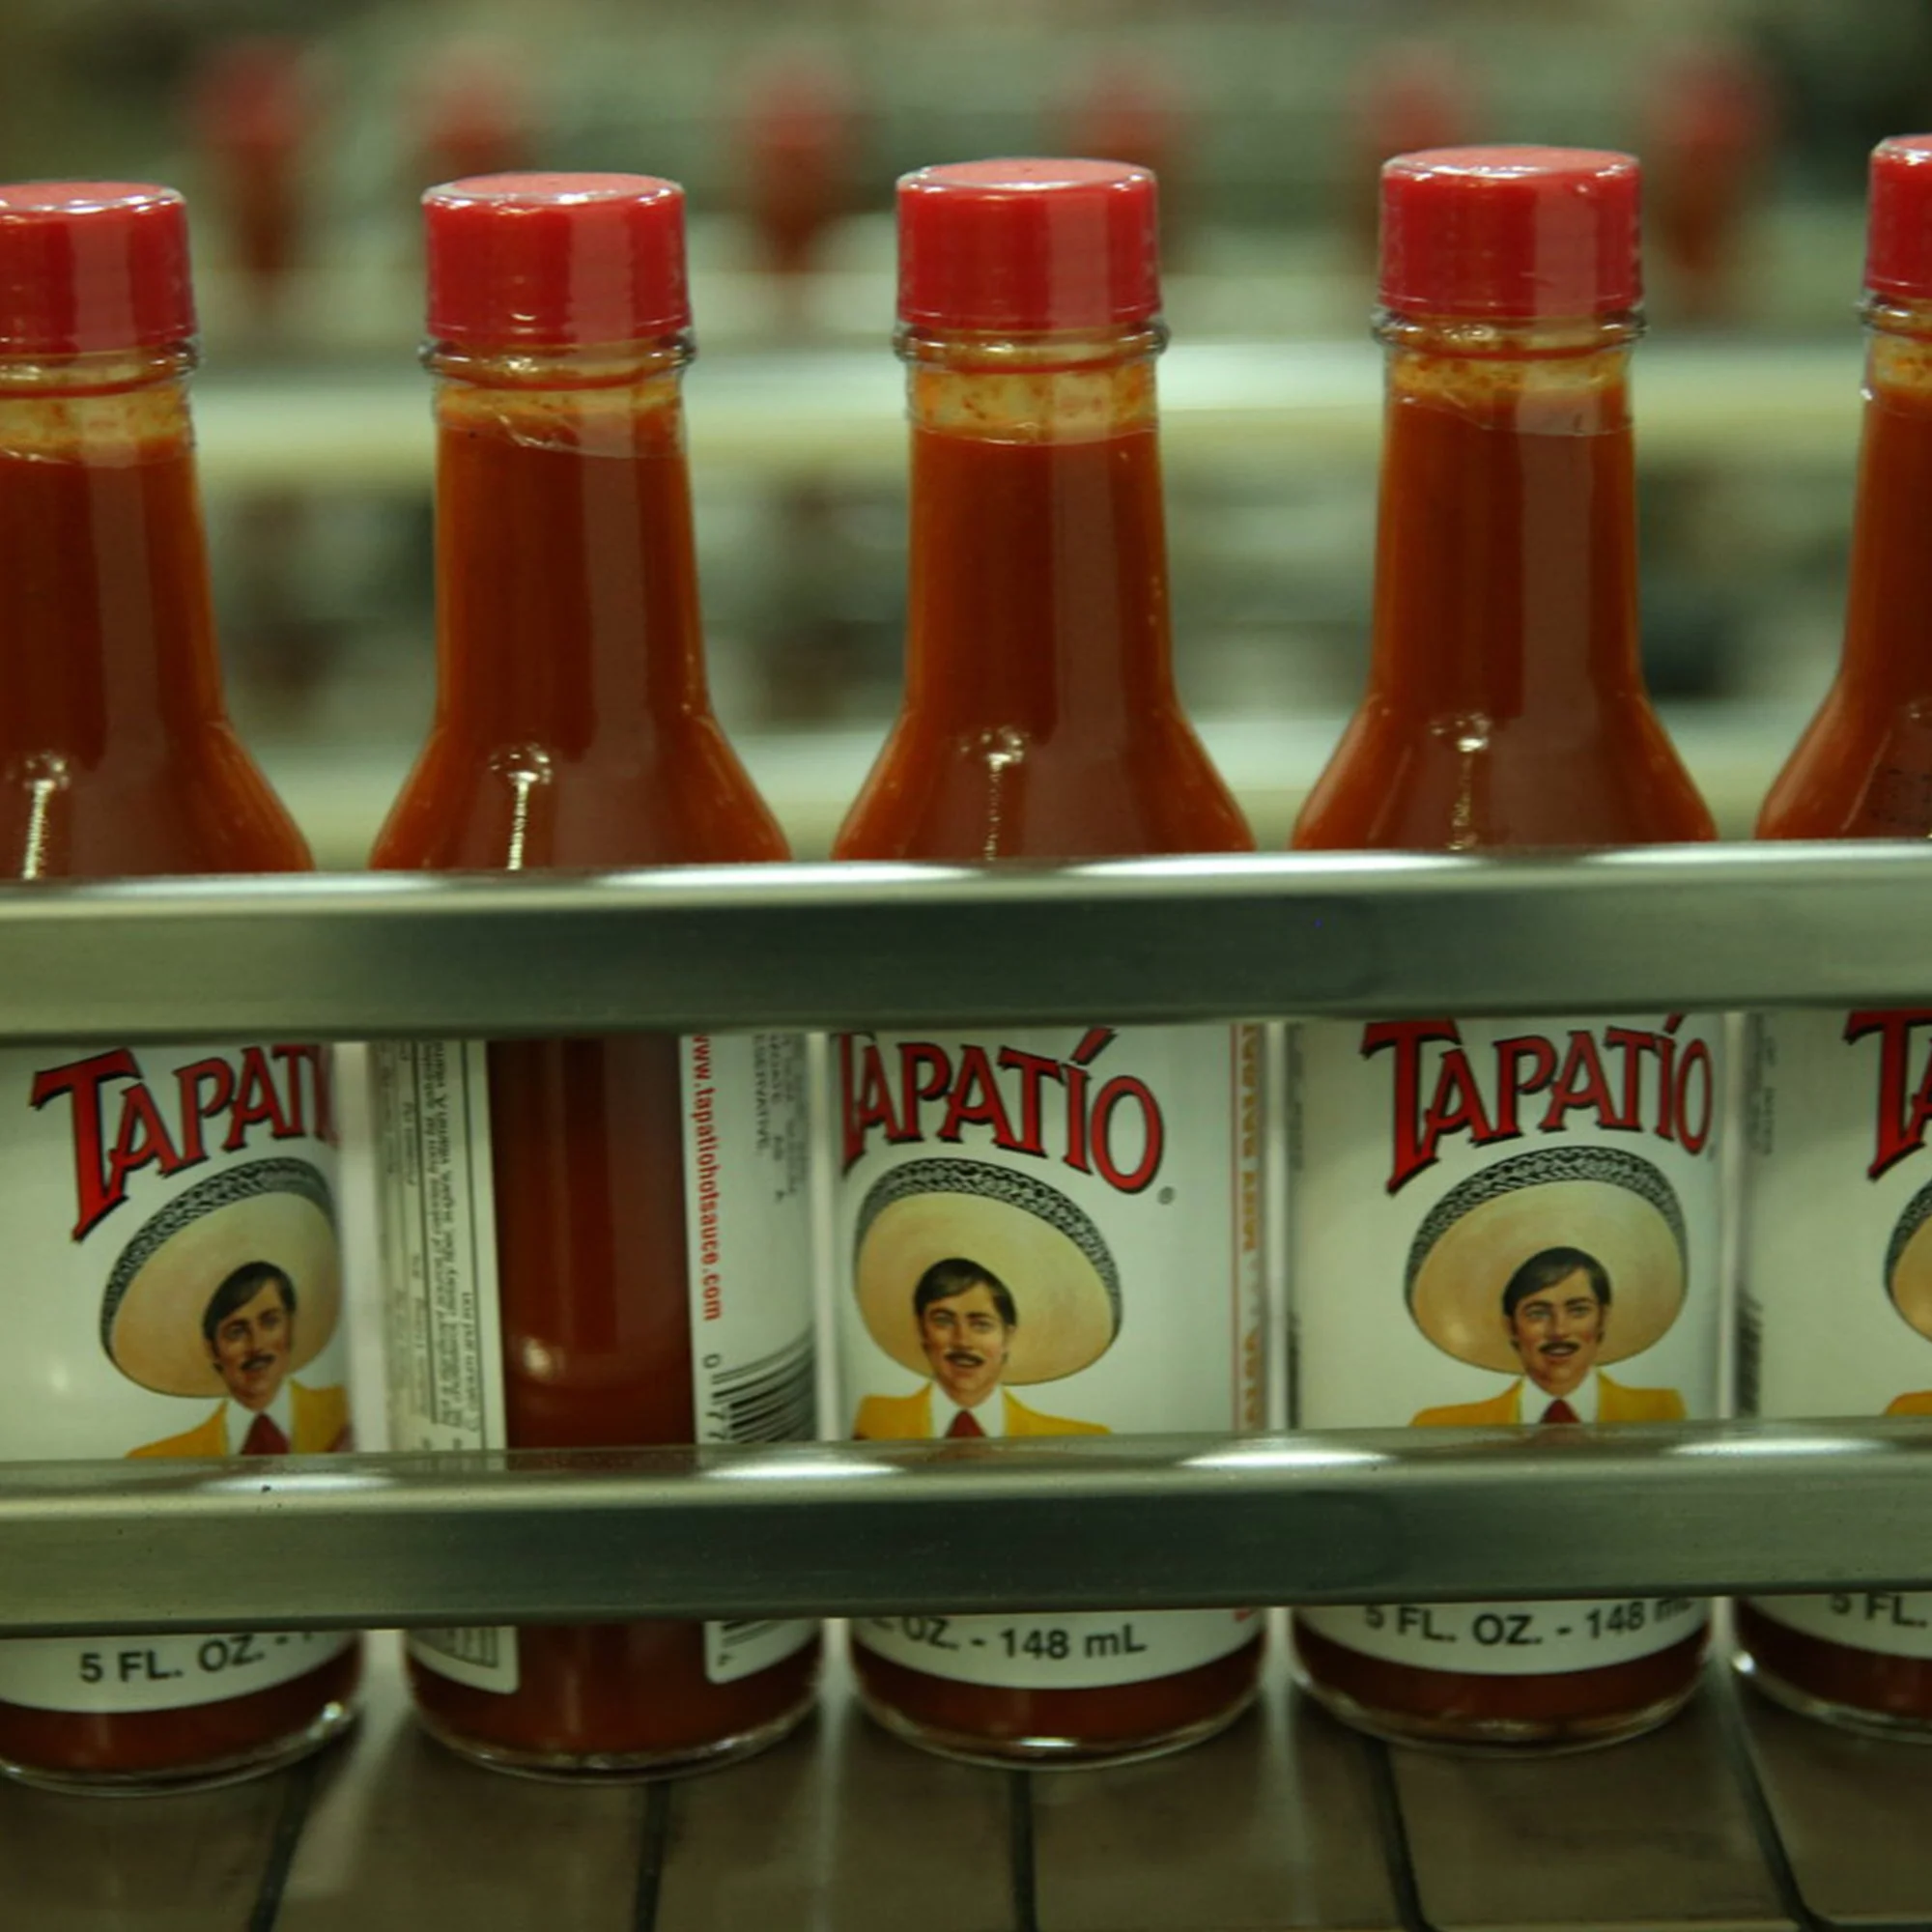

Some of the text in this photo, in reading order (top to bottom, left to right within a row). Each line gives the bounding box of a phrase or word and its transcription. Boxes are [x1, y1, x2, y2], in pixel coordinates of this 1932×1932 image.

[1361, 1013, 1713, 1195] TAPATÍO
[1000, 1628, 1071, 1660] 148
[1084, 1623, 1148, 1658] mL
[1365, 1604, 1385, 1631] 5
[1398, 1605, 1458, 1643] FL.
[1472, 1612, 1544, 1646] OZ.
[1586, 1600, 1646, 1640] 148
[80, 1652, 103, 1683] 5
[118, 1650, 184, 1683] FL.
[198, 1632, 266, 1673] OZ.
